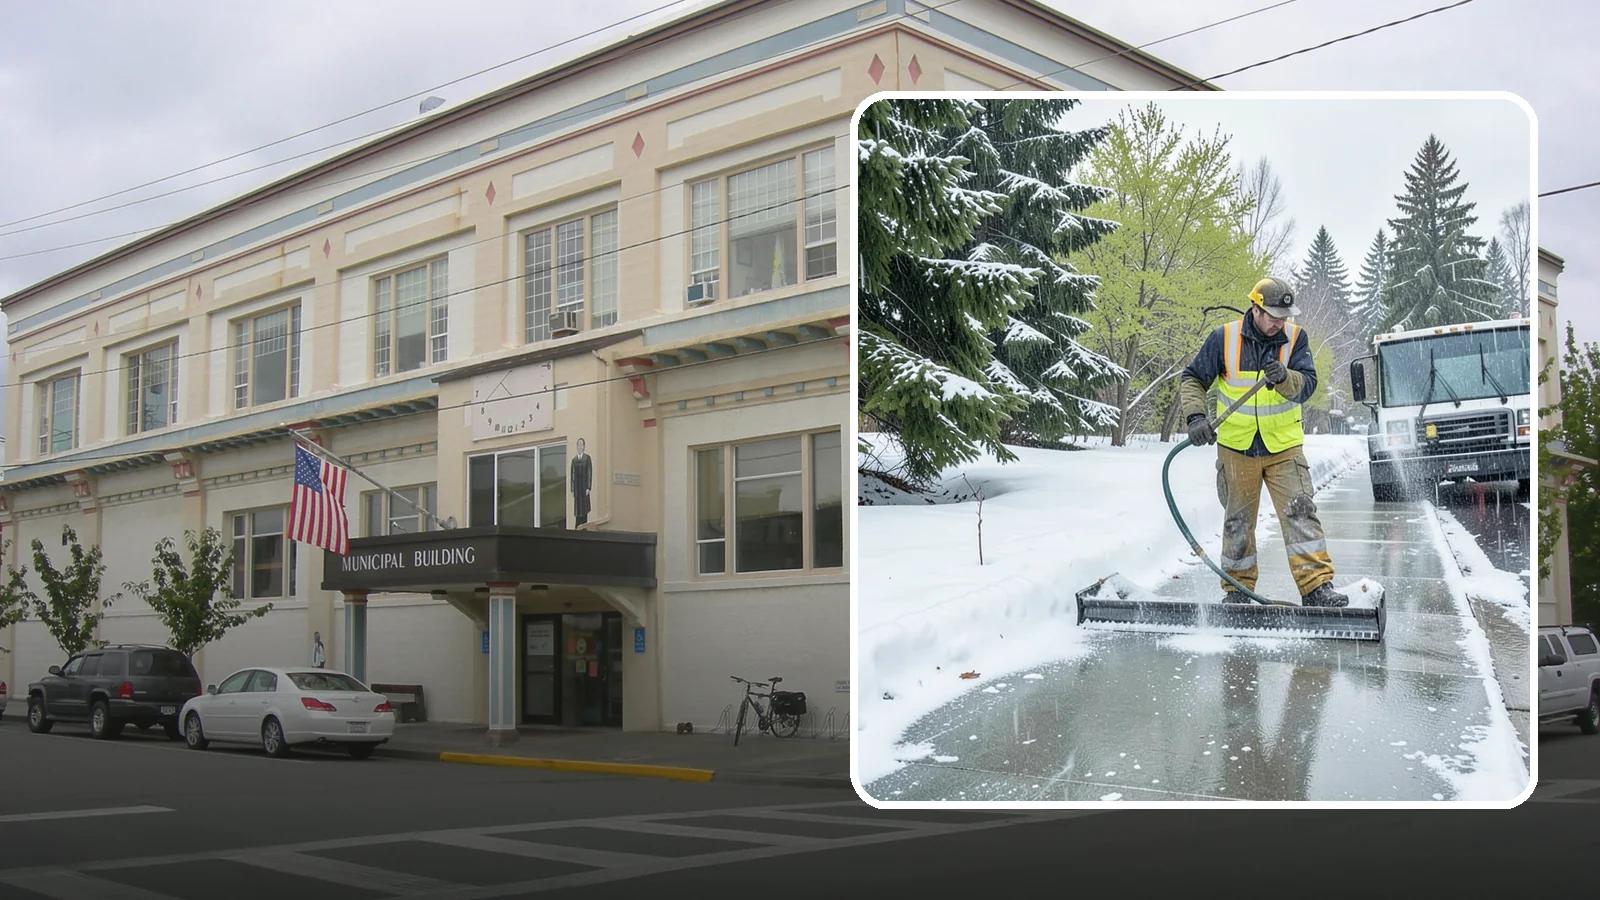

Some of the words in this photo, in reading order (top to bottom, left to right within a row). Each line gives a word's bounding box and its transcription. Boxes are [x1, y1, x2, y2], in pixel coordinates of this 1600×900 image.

[480, 406, 485, 415] 8
[487, 417, 492, 426] 9
[529, 413, 533, 422] 3
[521, 420, 526, 428] 2
[507, 425, 513, 433] 12
[342, 552, 405, 572] MUNICIPAL
[414, 546, 476, 567] BUILDING
